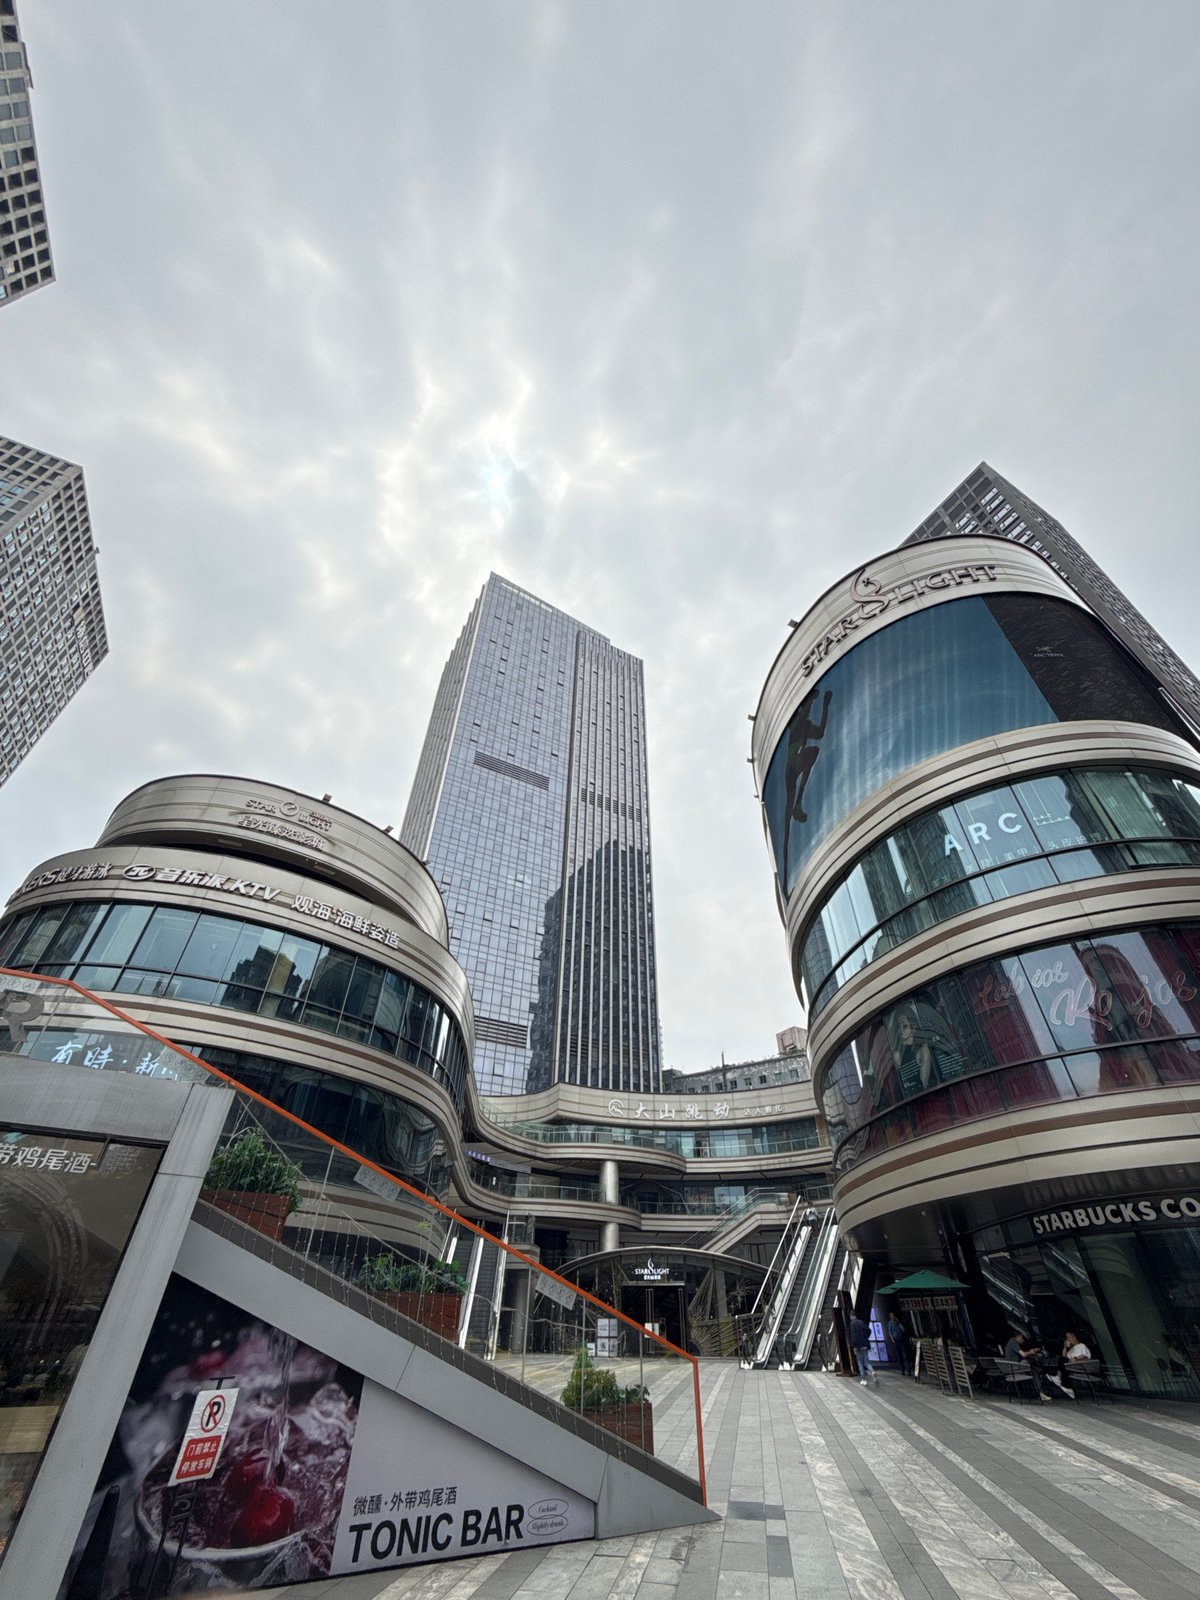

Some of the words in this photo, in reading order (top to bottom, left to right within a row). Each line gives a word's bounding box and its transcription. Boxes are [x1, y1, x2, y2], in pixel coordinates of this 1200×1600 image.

[803, 618, 859, 678] STAR
[893, 565, 996, 604] LIGHT
[245, 800, 277, 814] STAR
[299, 813, 333, 832] LIGHT
[944, 812, 1023, 857] ARC
[634, 1102, 730, 1120] 大山跳动
[1033, 1201, 1157, 1234] STARBUCKS
[186, 1441, 217, 1457] 门前禁止
[180, 1456, 214, 1475] 停放车辆
[352, 1486, 458, 1517] 微醺·外带鸡尾酒
[348, 1511, 453, 1564] TONIC
[460, 1503, 525, 1548] BAR
